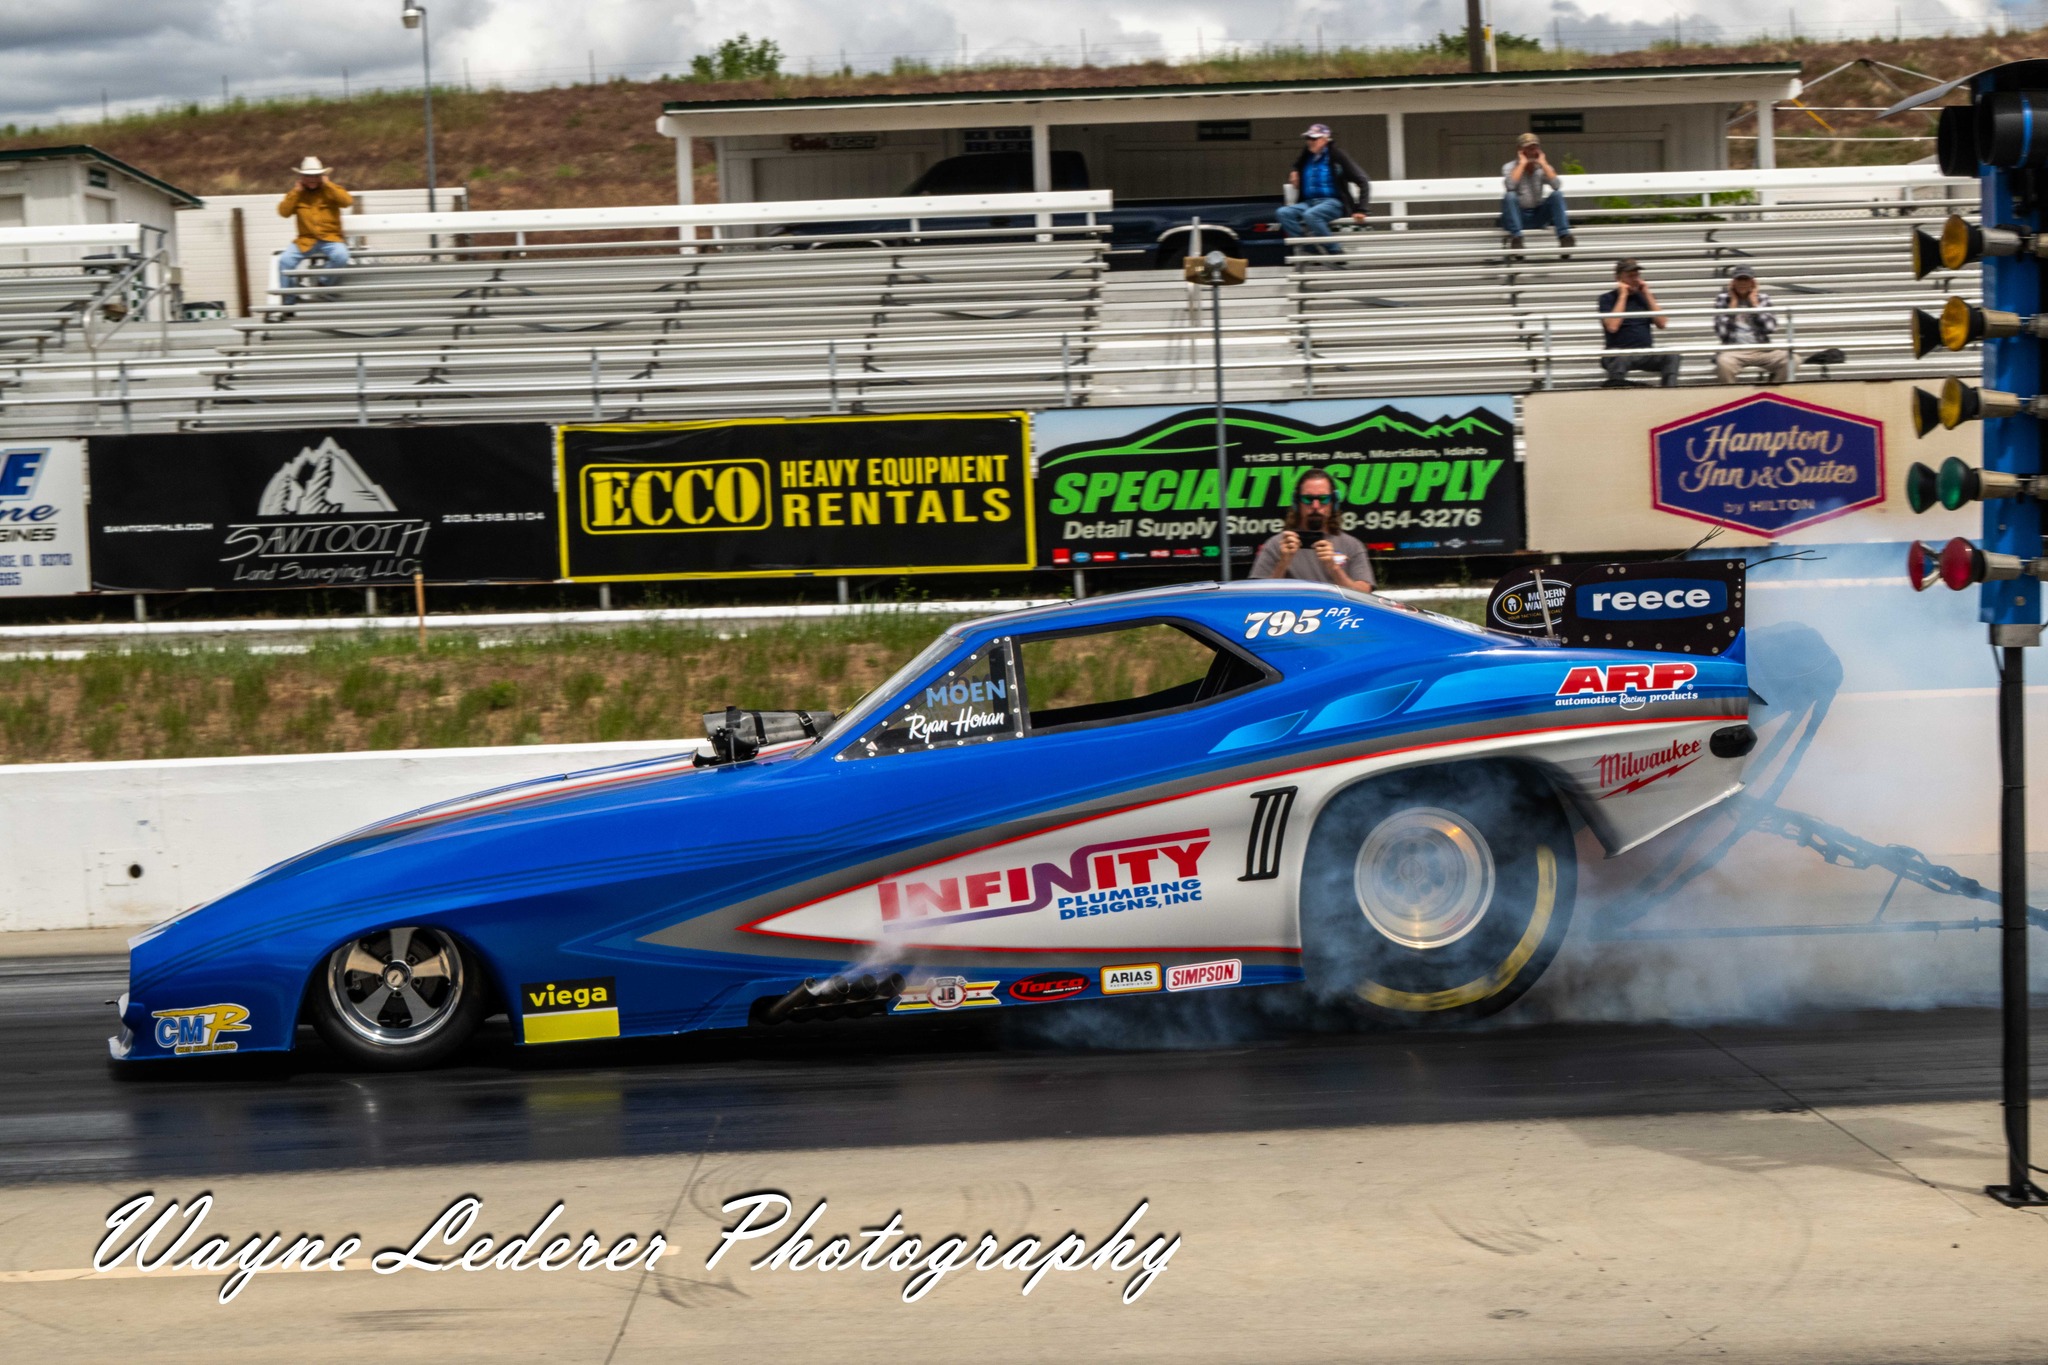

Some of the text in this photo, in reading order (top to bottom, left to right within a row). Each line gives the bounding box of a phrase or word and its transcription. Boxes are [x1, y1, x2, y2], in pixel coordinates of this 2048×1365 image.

[1242, 446, 1488, 463] 1129 E Pine Ave, Meridian, Idaho
[1686, 423, 1843, 463] Hampton
[780, 454, 1009, 488] HEAVY EQUIPMENT
[1678, 457, 1858, 493] Inn & Suites
[590, 467, 761, 526] ECCO
[1049, 465, 1314, 515] SPECIALTY
[781, 488, 1011, 528] RENTALS
[1724, 499, 1816, 515] by HILTON
[219, 521, 431, 562] SAWTOOTH
[1062, 515, 1285, 540] Detail Supply Store
[233, 562, 280, 580] Land
[1593, 588, 1711, 612] reece
[1244, 608, 1324, 639] 795
[926, 679, 1006, 708] MOEN
[1555, 662, 1698, 696] ARP
[1555, 691, 1698, 710] automotive Racing products
[905, 706, 1005, 744] Ryan Horan
[1592, 739, 1702, 788] Milwaukee
[877, 828, 1212, 930] INFINITY
[1058, 878, 1201, 909] PLUMBING
[1060, 890, 1202, 920] DESIGNS, INC
[1019, 976, 1085, 994] Torco
[1110, 971, 1153, 984] ARIAS
[1172, 964, 1234, 987] SIMPSON
[529, 983, 608, 1008] viega
